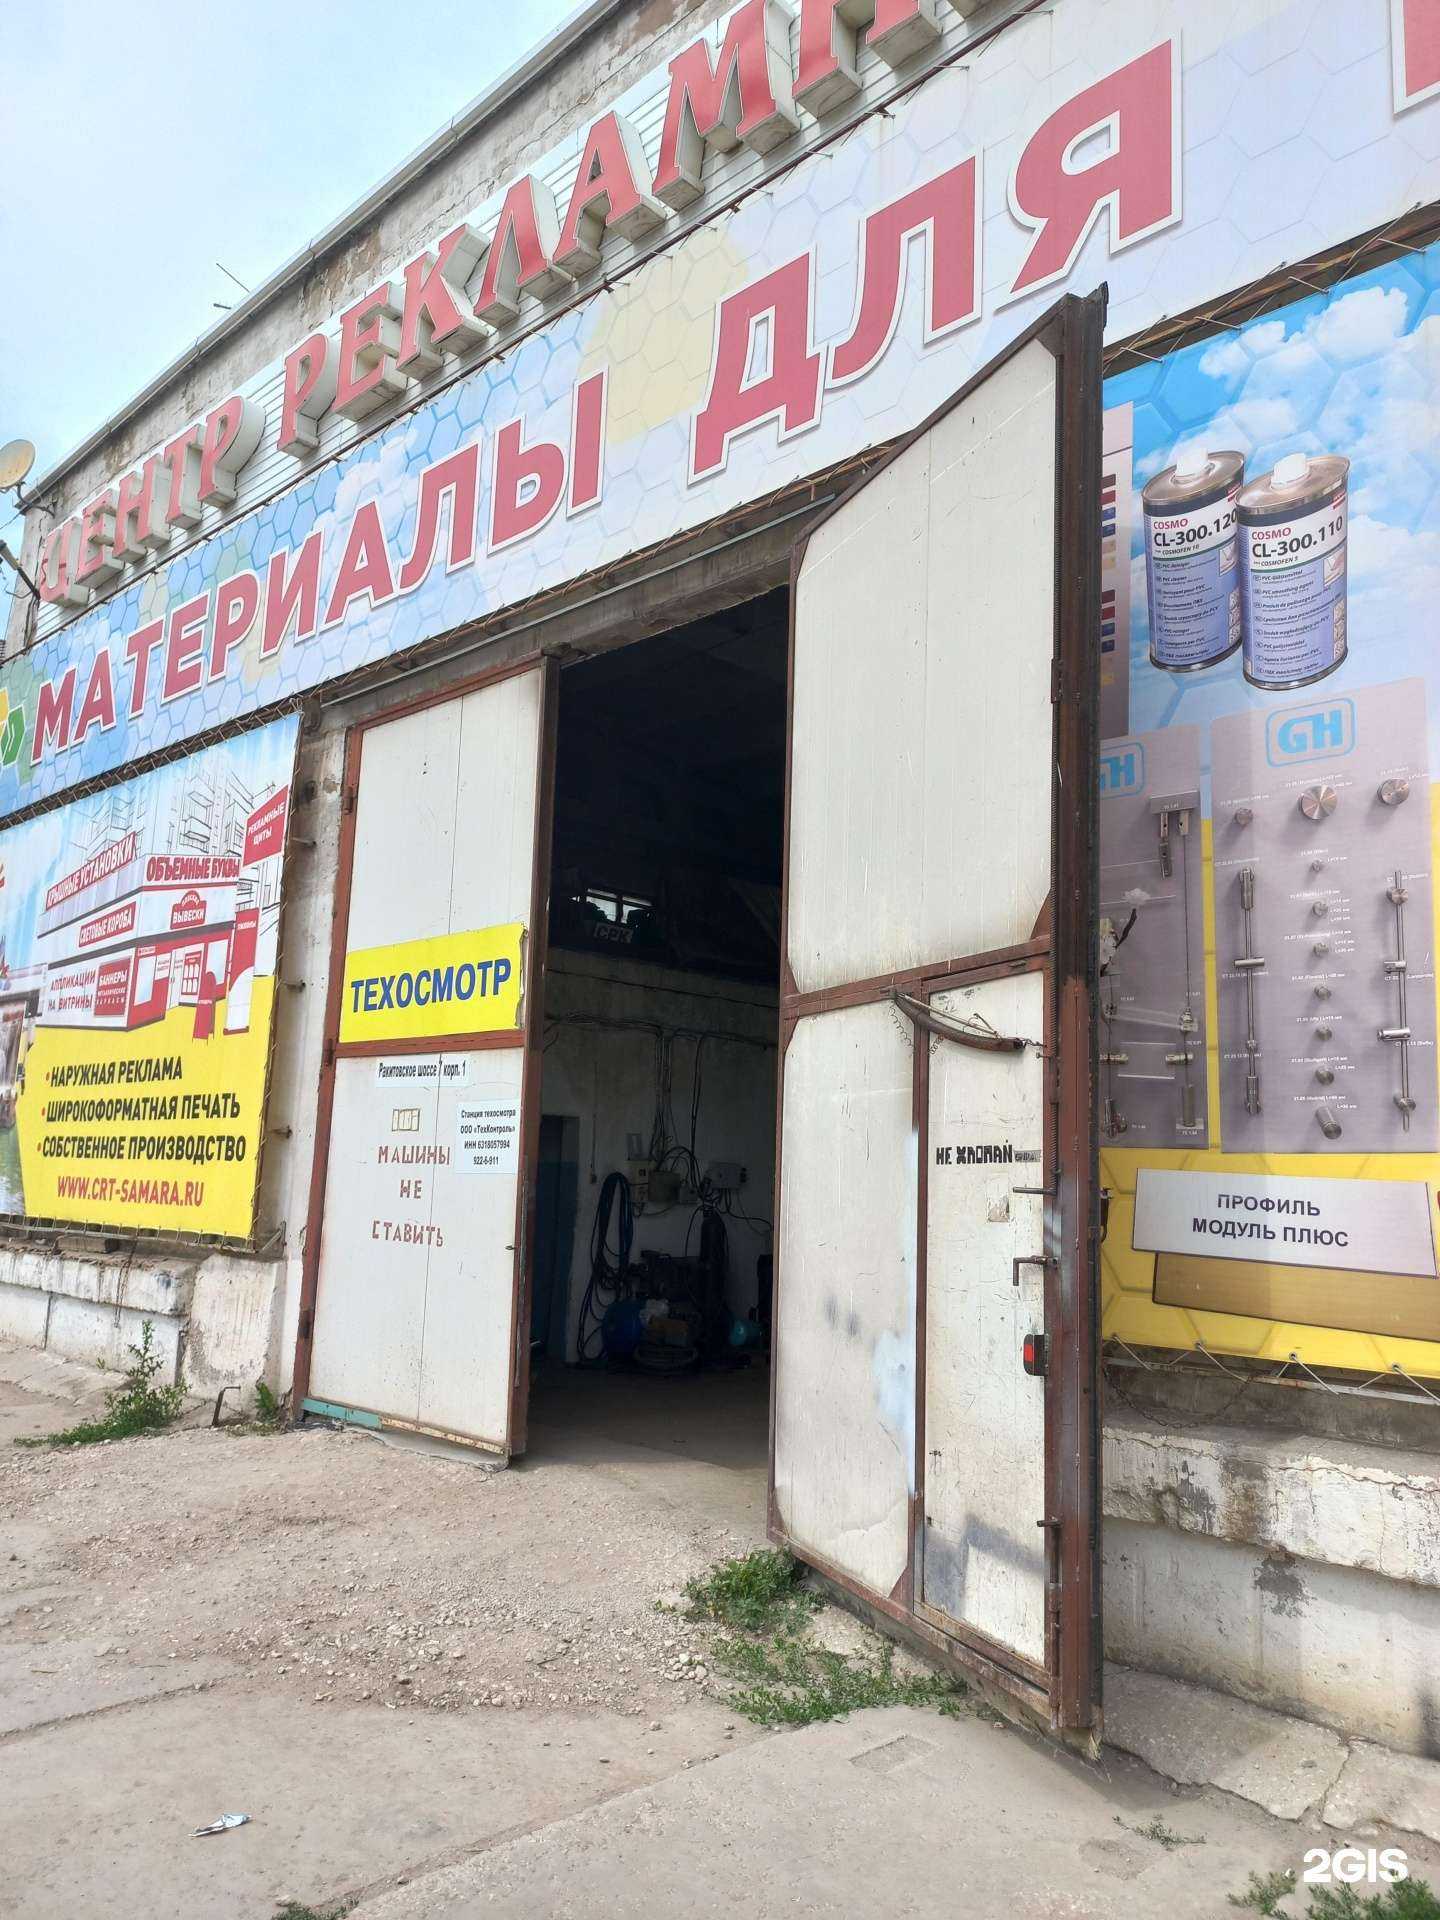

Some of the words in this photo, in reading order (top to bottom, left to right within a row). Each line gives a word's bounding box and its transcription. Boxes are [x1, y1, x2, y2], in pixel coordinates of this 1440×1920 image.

[32, 373, 606, 761] МАТЕРИАЛЫ
[692, 38, 1176, 477] ДЛЯ
[40, 395, 250, 603] ЦЕНТР
[1154, 518, 1188, 530] COSMO
[1154, 508, 1237, 547] CL-300.120
[1251, 527, 1291, 540] COSMO
[1252, 516, 1343, 558] CL-300.110
[247, 801, 286, 837] РЕКЛАМНЫЕ
[253, 826, 273, 846] ЩИТЫ
[80, 834, 134, 889] УСТАНОВКИ
[146, 857, 211, 882] ОБЪЕМНЫЕ
[211, 857, 240, 878] БУКВЫ
[80, 920, 107, 943] СВЕТОВЫЕ
[107, 910, 132, 932] КОРОБА
[173, 909, 204, 923] ВЫВЕСКИ
[99, 970, 128, 986] БАННЕРЫ
[351, 958, 511, 1013] ТЕХОСМОТР
[48, 999, 56, 1011] НА
[58, 994, 93, 1011] ВИТРИНЫ
[51, 1062, 116, 1088] НАРУЖНАЯ
[117, 1056, 182, 1084] РЕКЛАМА
[378, 1063, 417, 1078] Ракитовское
[417, 1065, 437, 1077] шоссе
[443, 1063, 461, 1080] корп.
[461, 1060, 467, 1077] 1
[46, 1096, 177, 1123] ШИРОКОФОРМАТНАЯ
[181, 1092, 241, 1119] ПЕЧАТЬ
[461, 1109, 483, 1119] Станция
[484, 1108, 516, 1118] техосмотра
[460, 1125, 473, 1134] ООО
[42, 1135, 125, 1160] СОБСТВЕННОЕ
[127, 1135, 247, 1165] ПРОИЗВОДСТВО
[378, 1145, 450, 1165] МАШИНЫ
[464, 1140, 477, 1149] ИНН
[936, 1147, 952, 1165] НЕ
[57, 1175, 204, 1208] WWW.CRT-SAMARA.RU
[399, 1180, 423, 1200] НЕ
[1217, 1194, 1321, 1217] ПРОФИЛЬ
[372, 1220, 445, 1248] СТАВИТЬ
[1192, 1217, 1277, 1240] МОДУЛЬ
[1282, 1225, 1349, 1248] ПЛЮС
